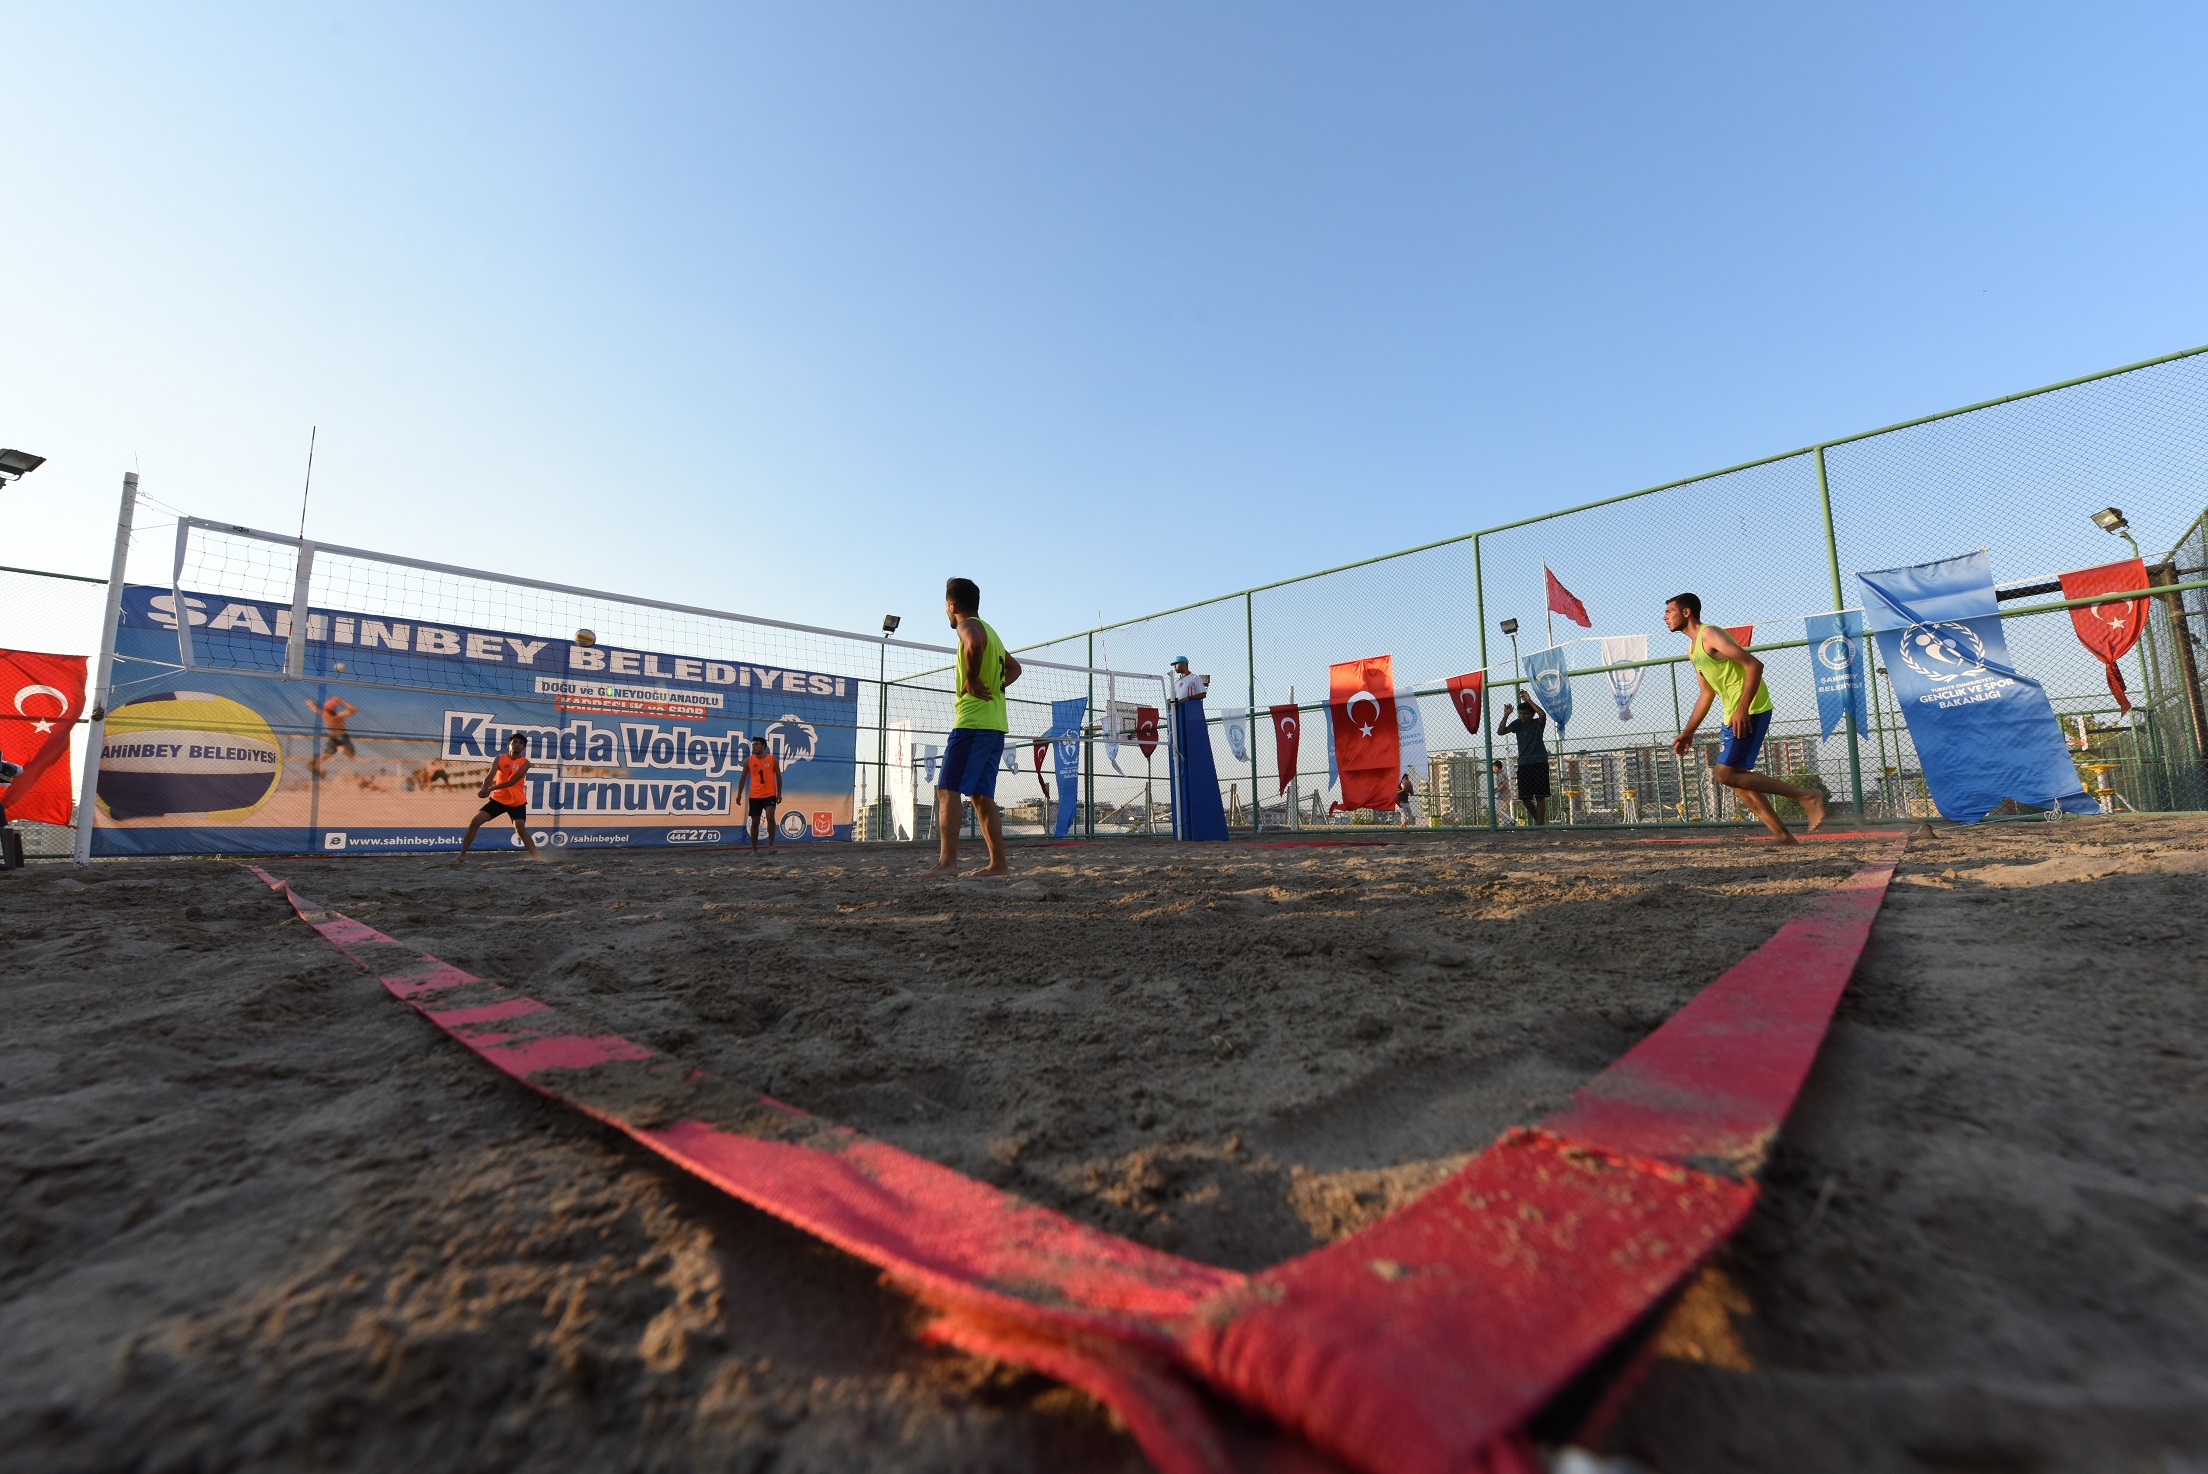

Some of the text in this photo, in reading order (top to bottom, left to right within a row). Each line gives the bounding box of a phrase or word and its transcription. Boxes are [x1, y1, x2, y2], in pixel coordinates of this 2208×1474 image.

[541, 681, 719, 706] DOĞU ve GÜNEYDOĞU ANADOLU
[1967, 685, 1982, 694] VE
[1984, 677, 2016, 691] SPOR
[100, 743, 184, 759] AHİNBEY
[448, 715, 782, 775] Kumda Voleybl
[757, 769, 766, 785] 1
[525, 772, 728, 812] Turnuvası
[349, 835, 465, 847] www.sahinbey.bel.t
[570, 834, 630, 845] /sahinbeybel
[669, 833, 687, 841] 444
[688, 829, 708, 841] 27
